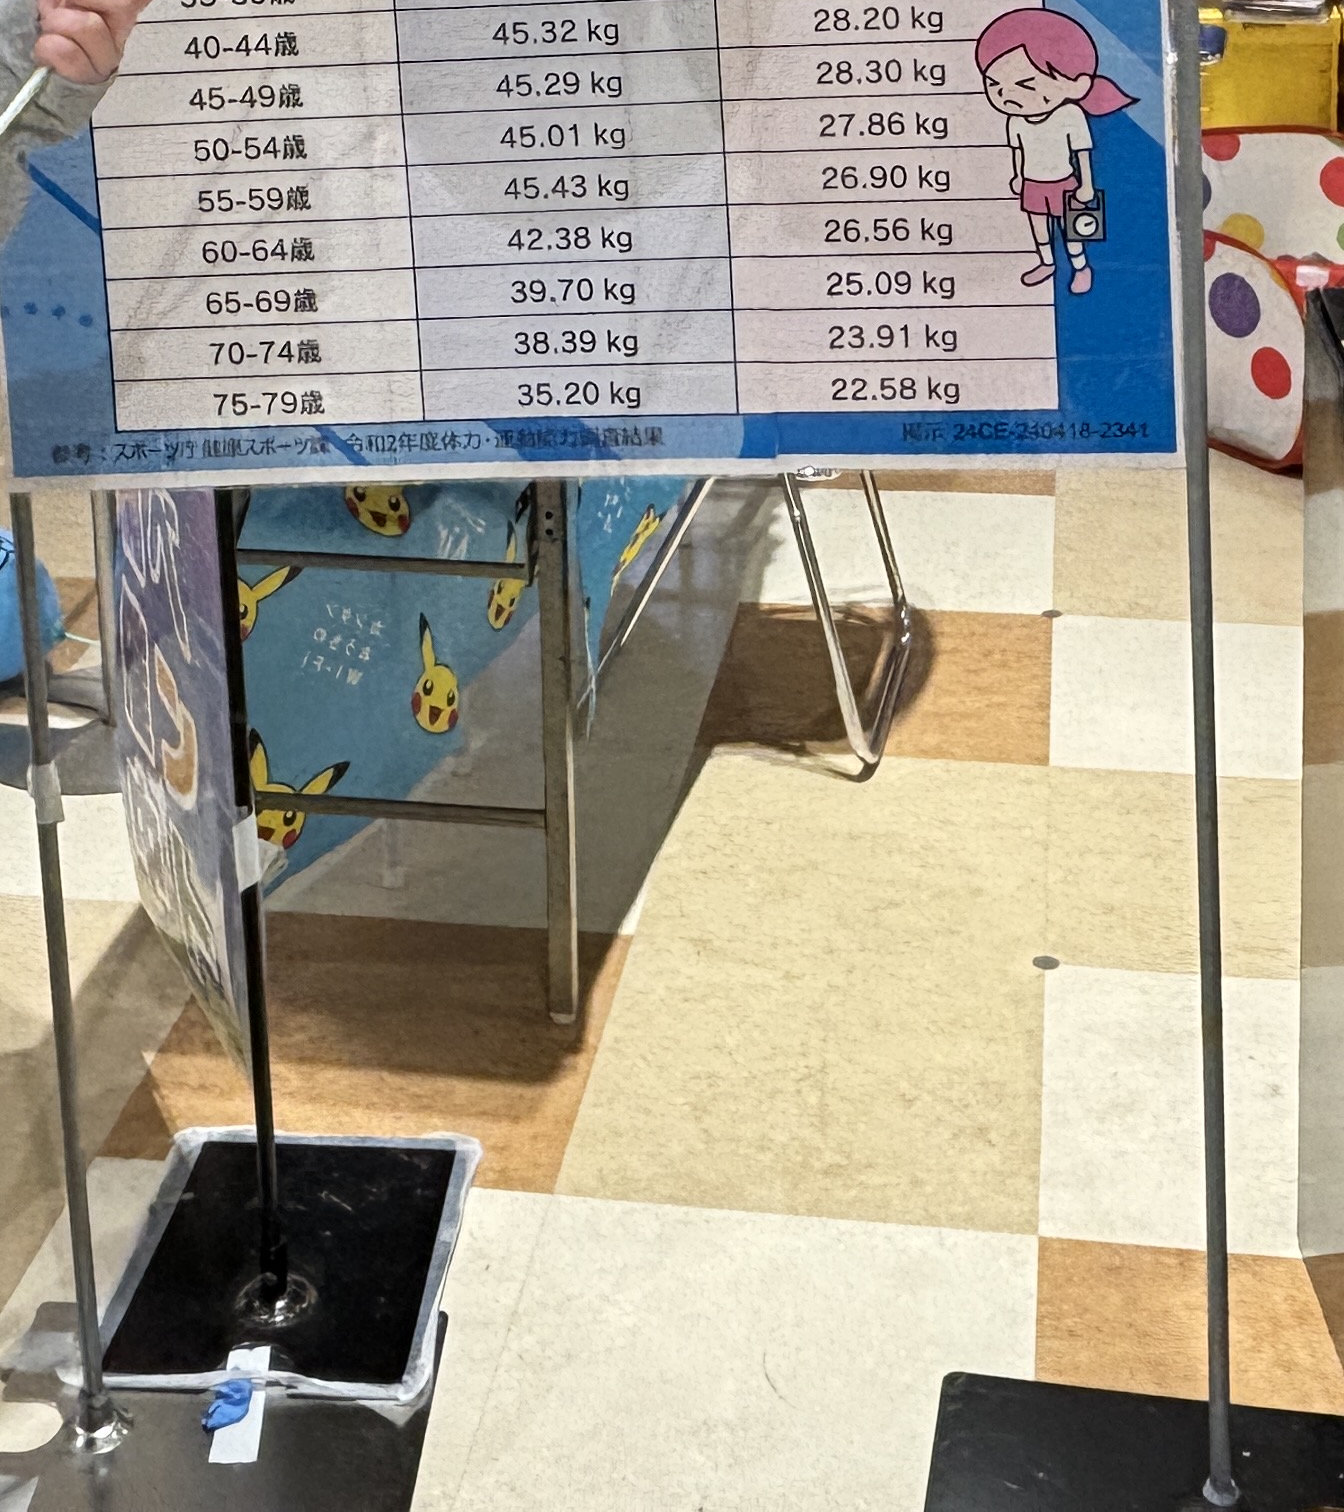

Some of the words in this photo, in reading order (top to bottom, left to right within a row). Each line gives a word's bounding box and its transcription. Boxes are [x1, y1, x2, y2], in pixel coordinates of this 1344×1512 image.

[492, 18, 578, 46] 45.32
[587, 18, 619, 47] kg
[814, 5, 899, 33] 28.20
[911, 5, 943, 34] kg
[184, 31, 299, 59] 40-44歳
[496, 70, 581, 99] 45.29
[591, 70, 622, 99] kg
[816, 58, 902, 86] 28.30
[913, 57, 945, 87] kg
[189, 83, 303, 111] 45-49歳
[500, 123, 578, 149] 45.01
[594, 121, 625, 151] kg
[819, 111, 905, 138] 27.86
[916, 111, 948, 141] kg
[193, 134, 307, 163] 50-54歳
[504, 174, 587, 201] 45.43
[598, 173, 629, 202] kg
[822, 164, 908, 194] 26.90
[917, 164, 950, 194] kg
[197, 185, 311, 214] 55-59歳
[507, 225, 592, 252] 42.38
[601, 226, 632, 254] kg
[824, 217, 910, 244] 26.56
[921, 217, 953, 247] kg
[202, 237, 315, 265] 60-64歳
[511, 277, 593, 308] 39.70
[604, 277, 635, 306] kg
[827, 270, 911, 299] 25.09
[923, 270, 955, 300] kg
[206, 288, 318, 315] 65-69歳
[209, 339, 322, 366] 70-74歳
[515, 329, 597, 356] 38.39
[606, 328, 639, 358] kg
[828, 323, 909, 351] 23.91
[925, 323, 957, 353] kg
[213, 390, 325, 418] 75-79歳
[518, 380, 599, 407] 35.20
[610, 380, 641, 410] kg
[832, 376, 917, 402] 22.58
[928, 375, 960, 405] kg
